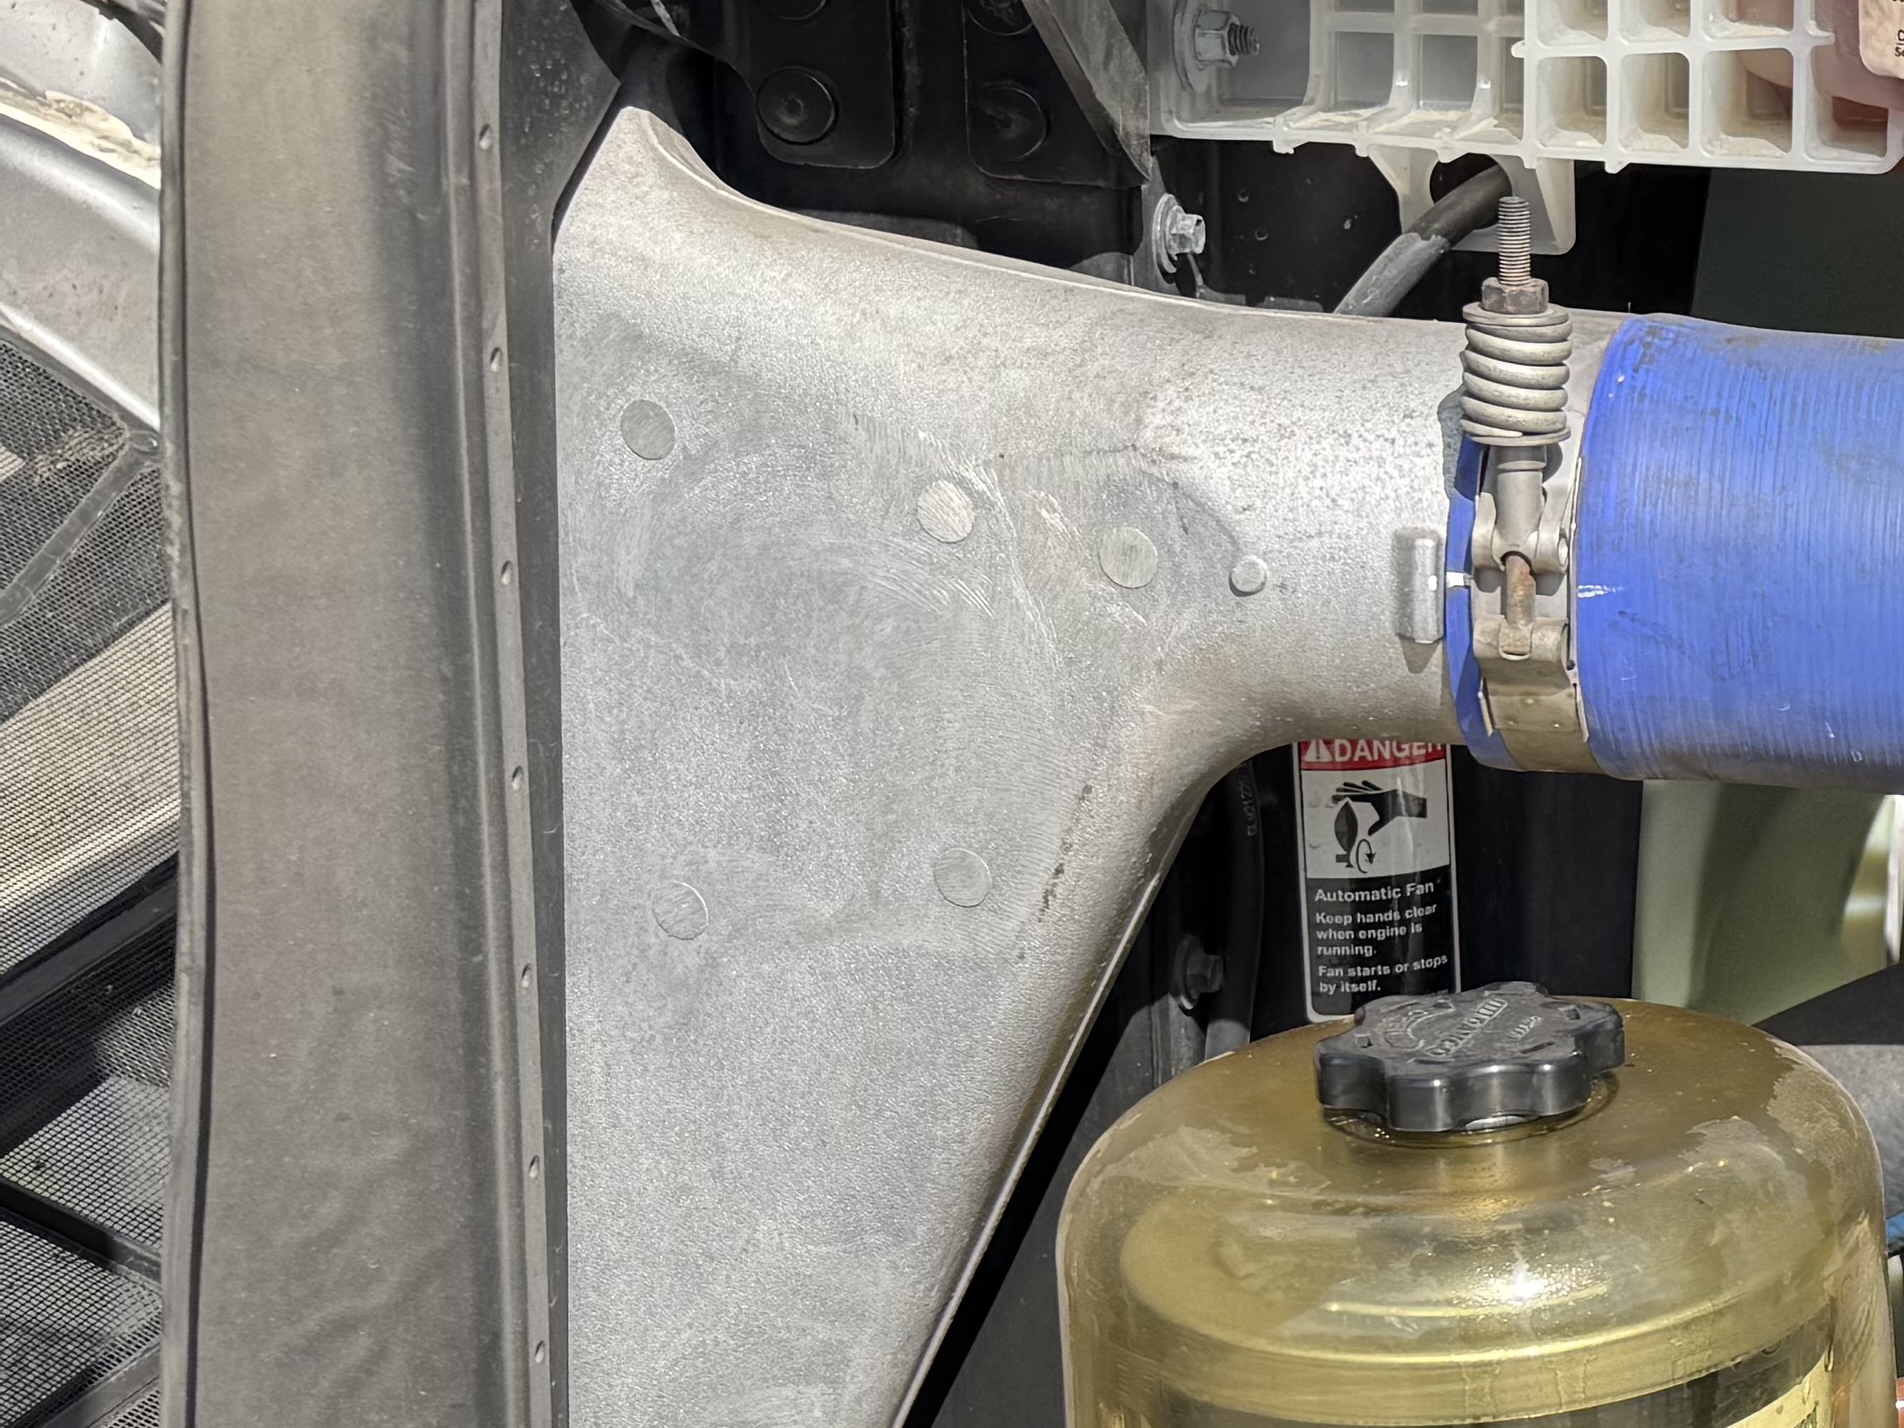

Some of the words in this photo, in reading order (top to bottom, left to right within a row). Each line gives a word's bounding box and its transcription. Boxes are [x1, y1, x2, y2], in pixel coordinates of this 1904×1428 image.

[1315, 885, 1402, 902] Automatic
[1406, 881, 1434, 895] Fan
[1316, 912, 1353, 926] Keep
[1356, 909, 1401, 923] hands
[1405, 903, 1437, 919] clear
[1316, 928, 1354, 940] when
[1359, 925, 1407, 941] engine
[1411, 921, 1423, 933] is
[1317, 943, 1378, 957] running.
[1319, 966, 1344, 977] Fan
[1348, 963, 1391, 976] starts
[1395, 962, 1410, 974] or
[1413, 954, 1449, 971] stops
[1319, 982, 1337, 995] by
[1340, 980, 1382, 992] itself.
